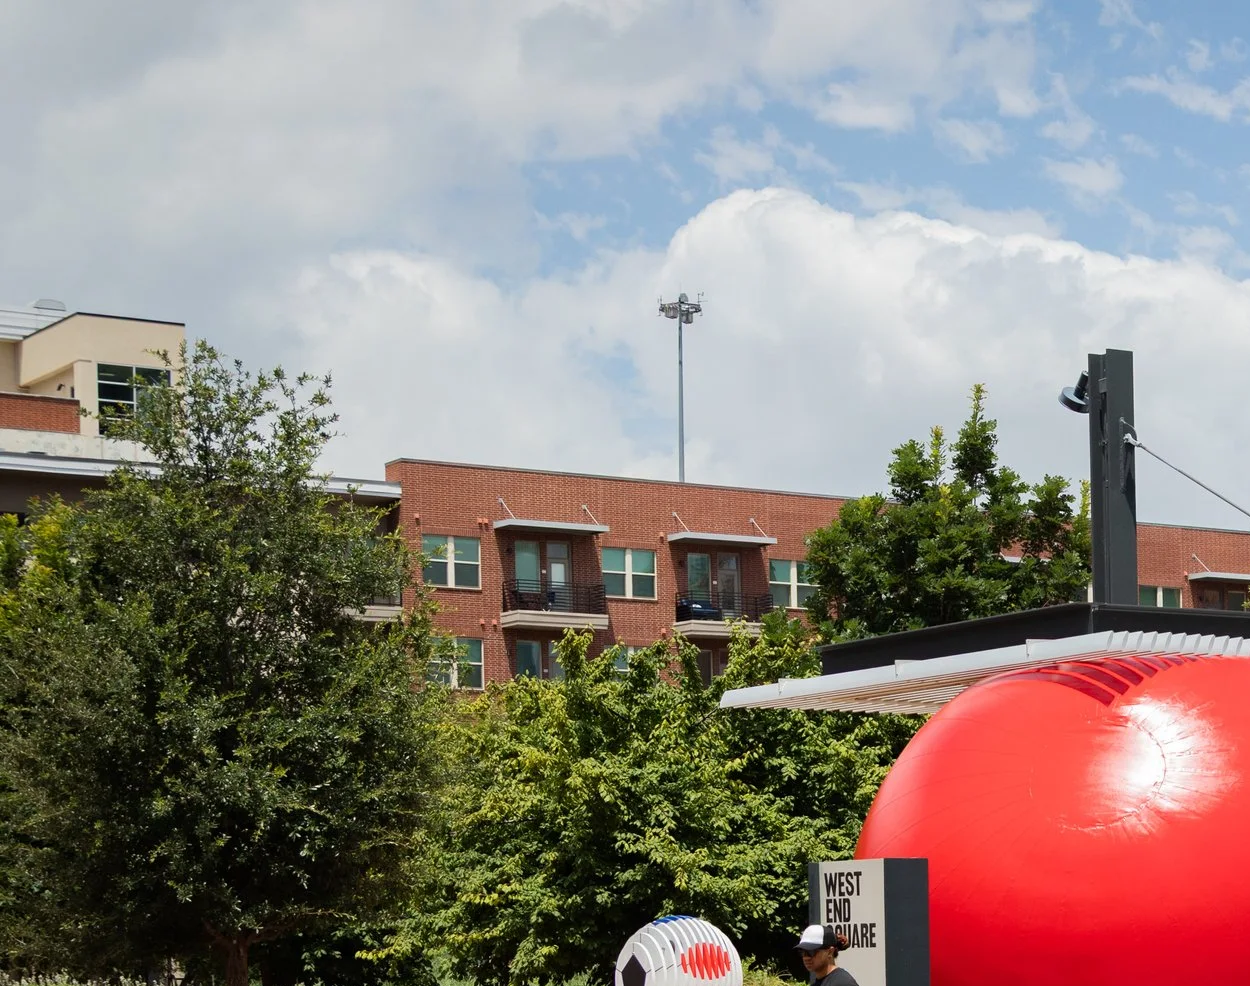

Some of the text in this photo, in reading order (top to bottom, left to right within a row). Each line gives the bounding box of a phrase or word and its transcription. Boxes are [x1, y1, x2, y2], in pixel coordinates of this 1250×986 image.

[824, 871, 862, 897] WEST
[826, 898, 851, 923] END
[827, 923, 876, 948] UARE
